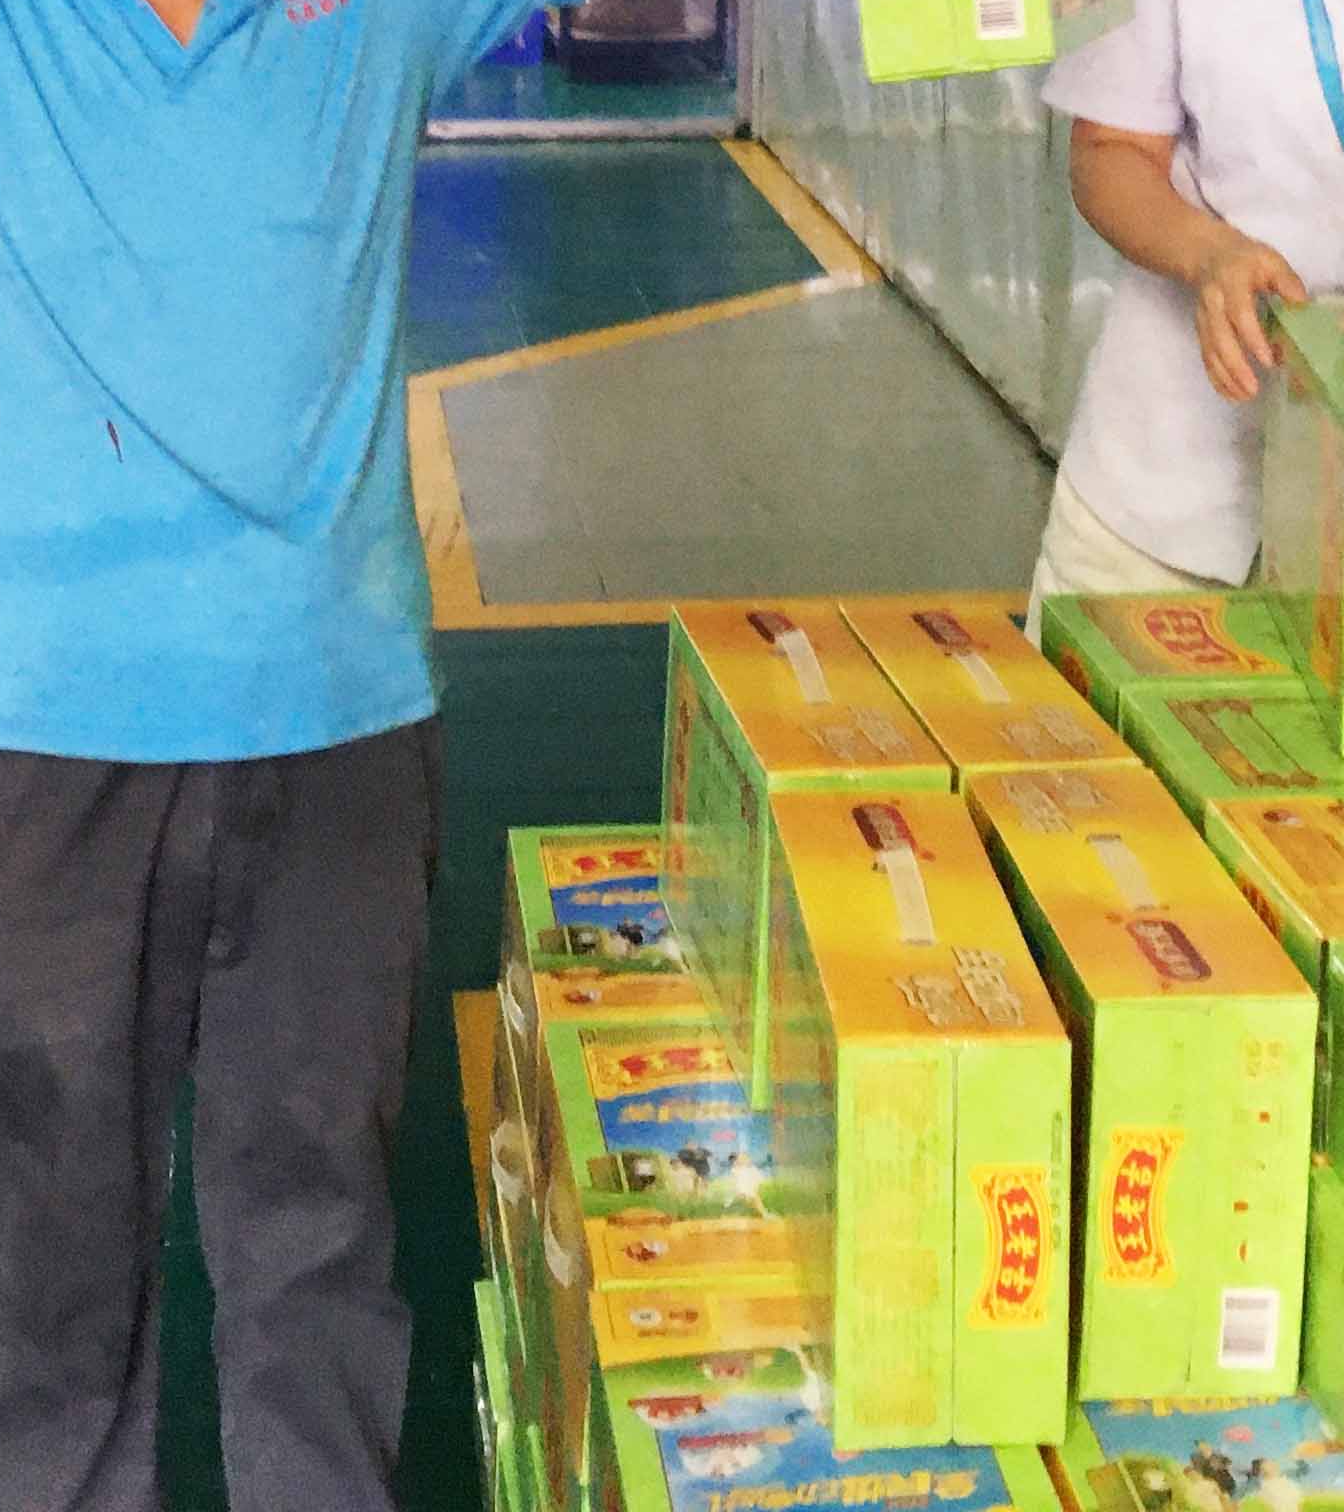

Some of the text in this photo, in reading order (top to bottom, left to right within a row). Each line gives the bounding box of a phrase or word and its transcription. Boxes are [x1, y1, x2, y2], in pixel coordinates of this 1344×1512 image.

[1002, 1199, 1036, 1295] 王老吉
[1115, 1162, 1152, 1254] 王老吉
